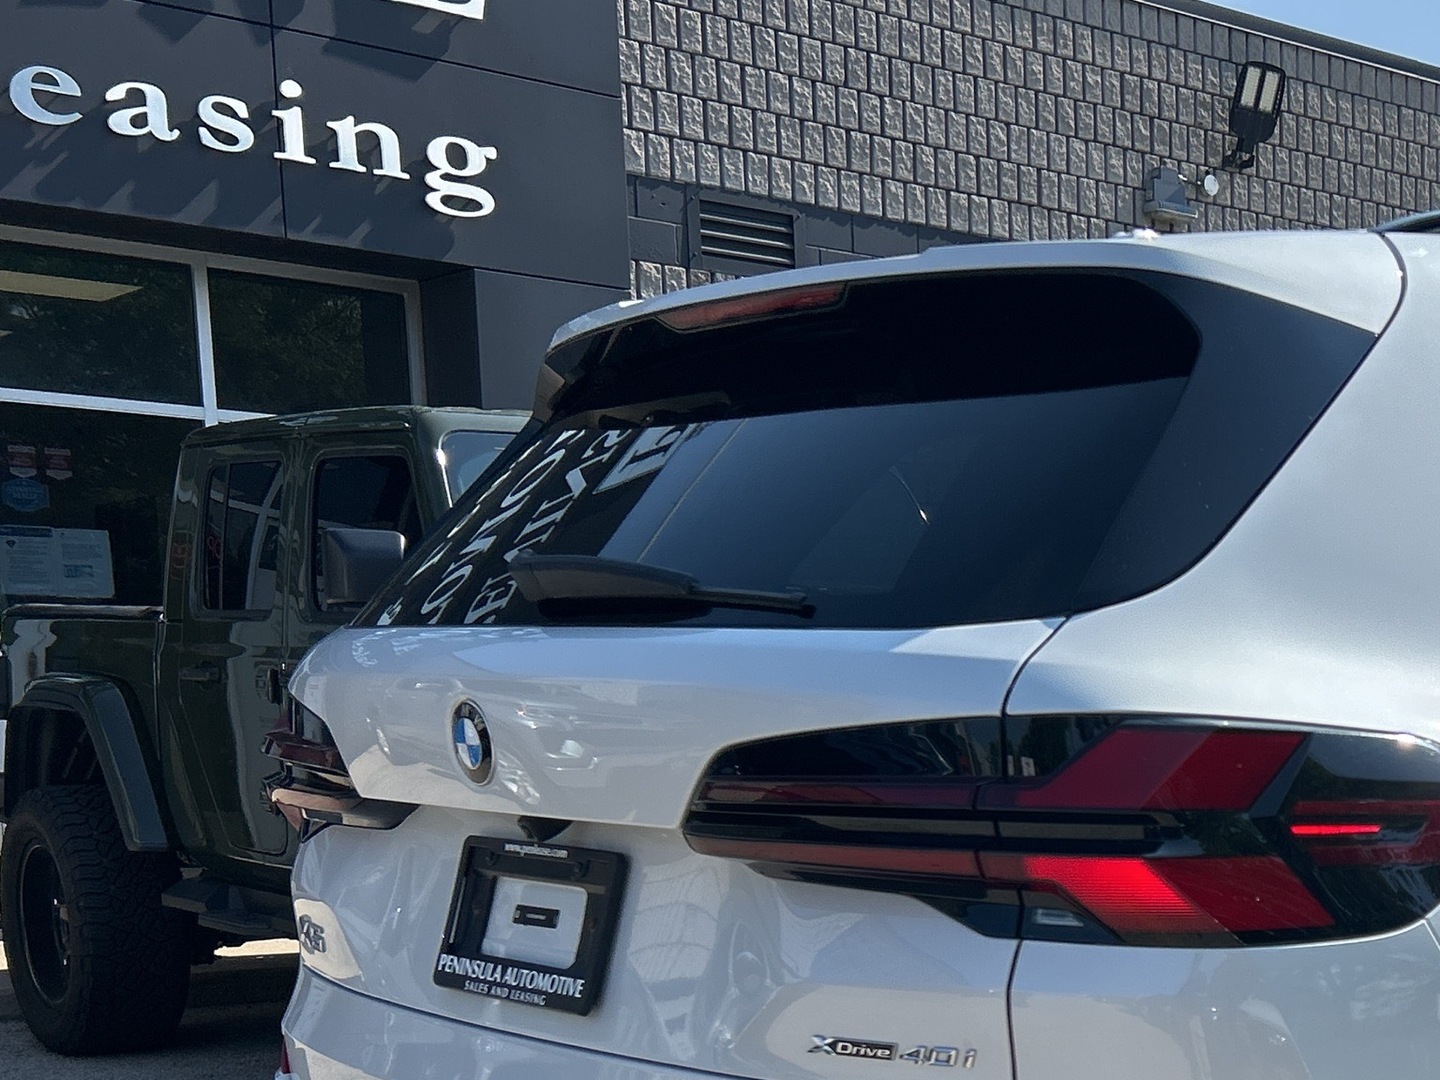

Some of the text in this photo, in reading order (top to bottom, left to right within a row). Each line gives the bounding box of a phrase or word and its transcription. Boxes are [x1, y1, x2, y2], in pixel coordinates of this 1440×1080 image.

[9, 65, 498, 217] easing
[438, 954, 585, 998] PENINSULA AUTOMOTIVE
[464, 980, 547, 1006] SALES AND LEASING
[900, 1045, 978, 1069] 40i
